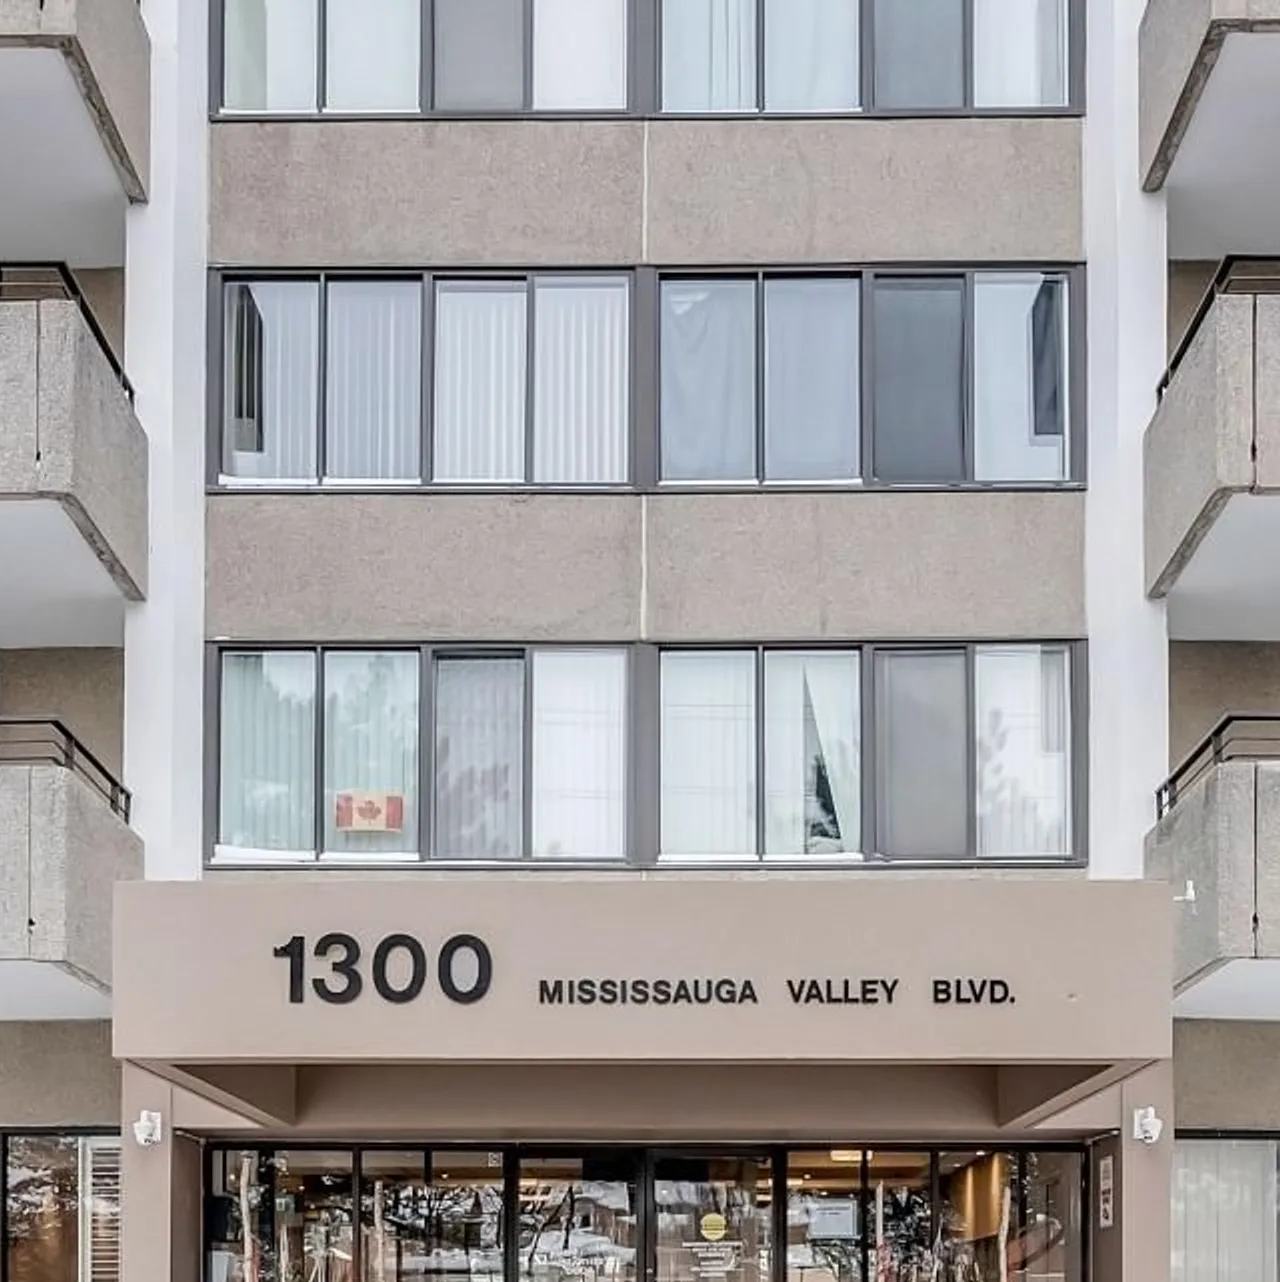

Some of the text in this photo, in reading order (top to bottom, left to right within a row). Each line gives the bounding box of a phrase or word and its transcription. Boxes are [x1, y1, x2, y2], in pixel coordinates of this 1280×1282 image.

[273, 932, 1016, 1005] 1300 MISSISSAUGA VALLEY BLVD.
